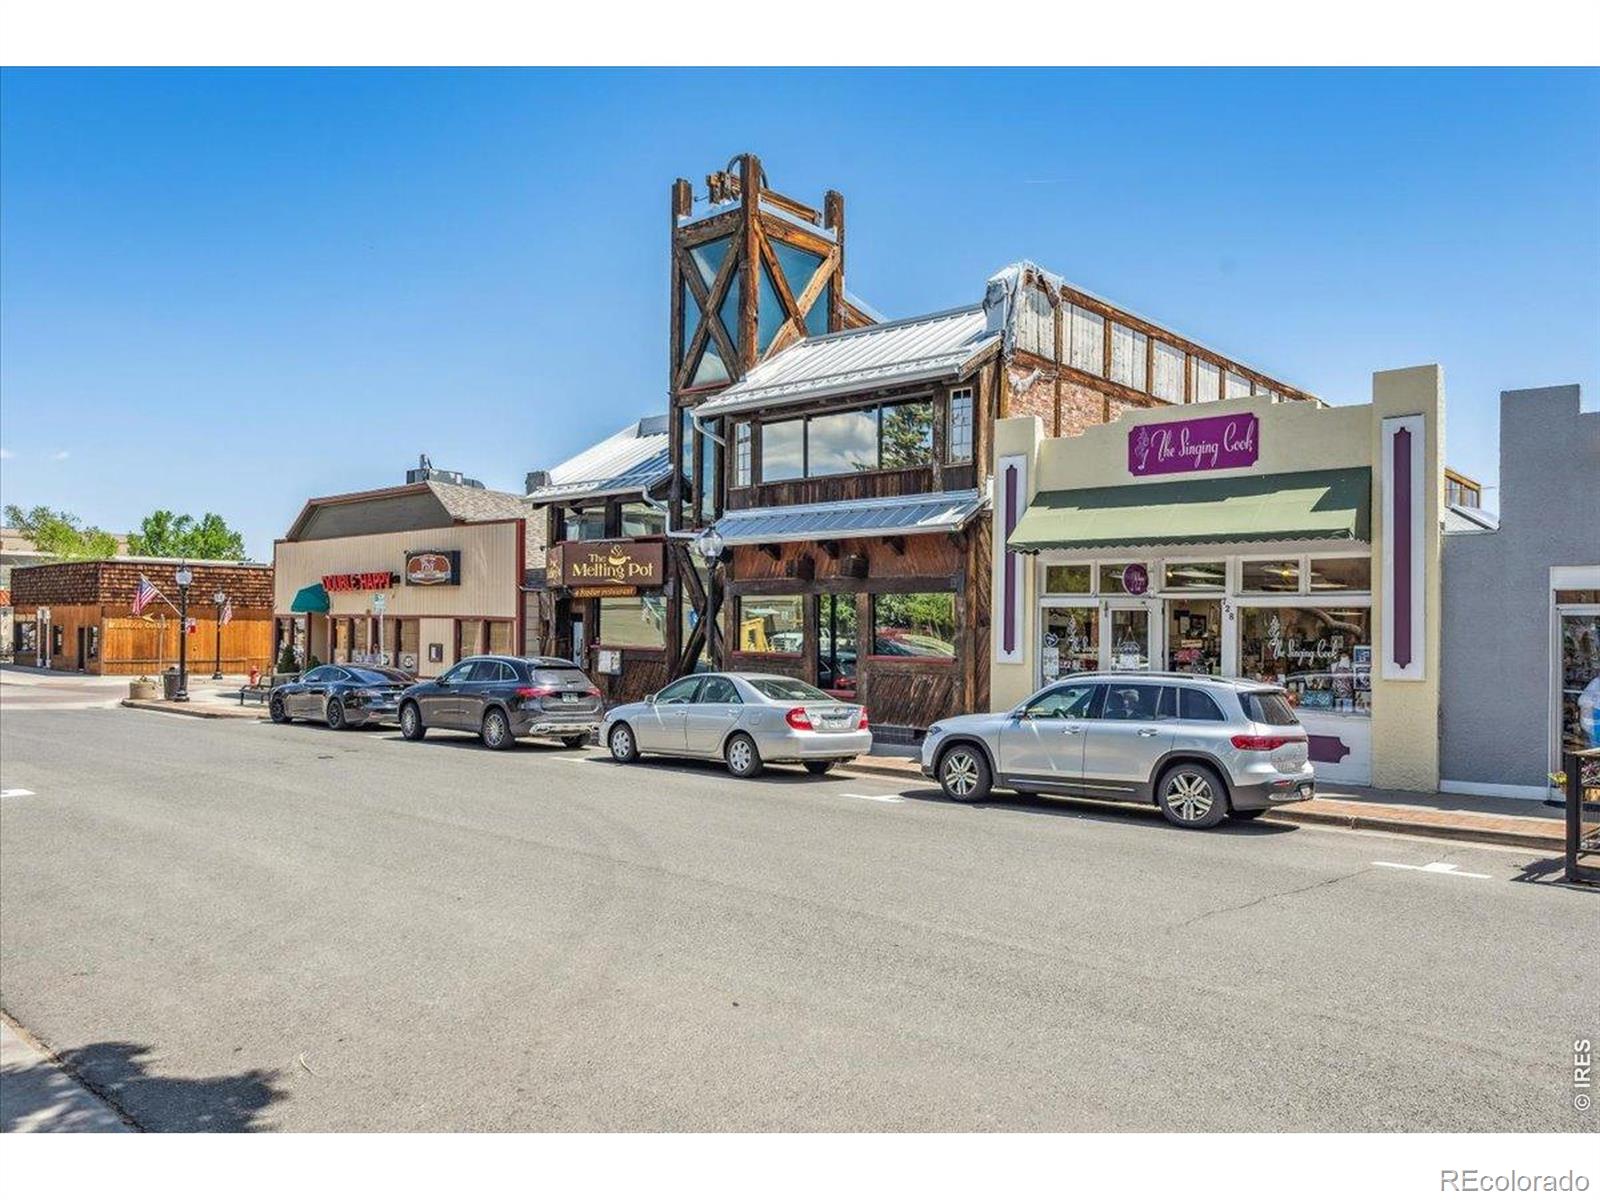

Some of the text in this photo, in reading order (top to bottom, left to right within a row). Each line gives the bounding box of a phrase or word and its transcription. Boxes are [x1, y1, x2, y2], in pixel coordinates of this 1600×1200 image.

[1151, 420, 1256, 468] The Singing Cook
[588, 553, 607, 563] The
[361, 570, 391, 590] HAPPY
[572, 563, 625, 579] Melting
[628, 563, 654, 577] Pot
